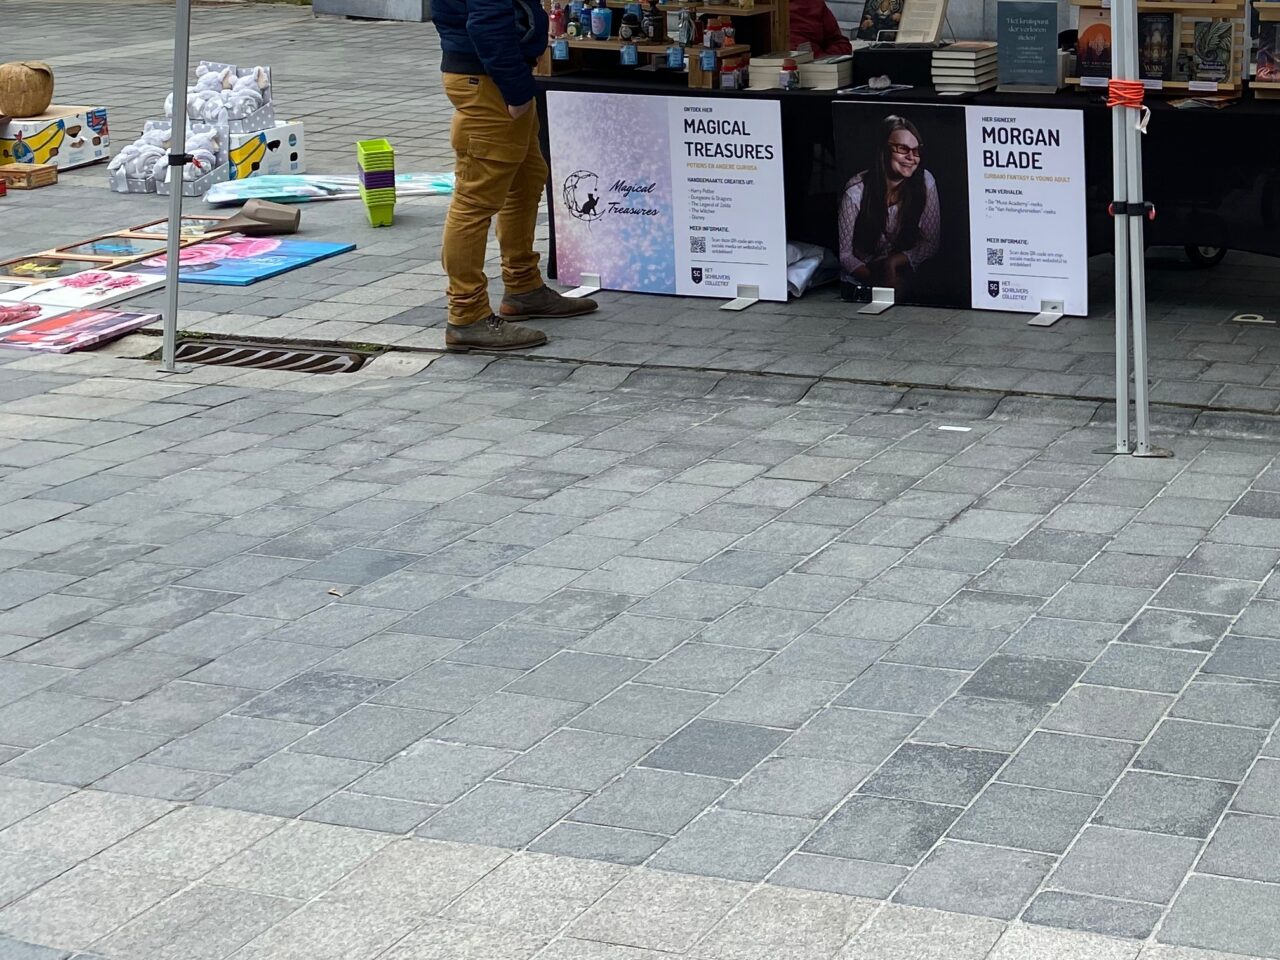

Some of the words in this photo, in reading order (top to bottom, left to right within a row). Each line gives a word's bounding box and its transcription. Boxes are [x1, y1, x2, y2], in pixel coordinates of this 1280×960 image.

[684, 118, 751, 136] MAGICAL
[982, 126, 1060, 147] MORGAN
[684, 141, 774, 160] TREASURES
[983, 150, 1043, 170] BLADE
[609, 179, 656, 198] Magical
[608, 201, 660, 216] Treasures
[990, 283, 998, 291] SC
